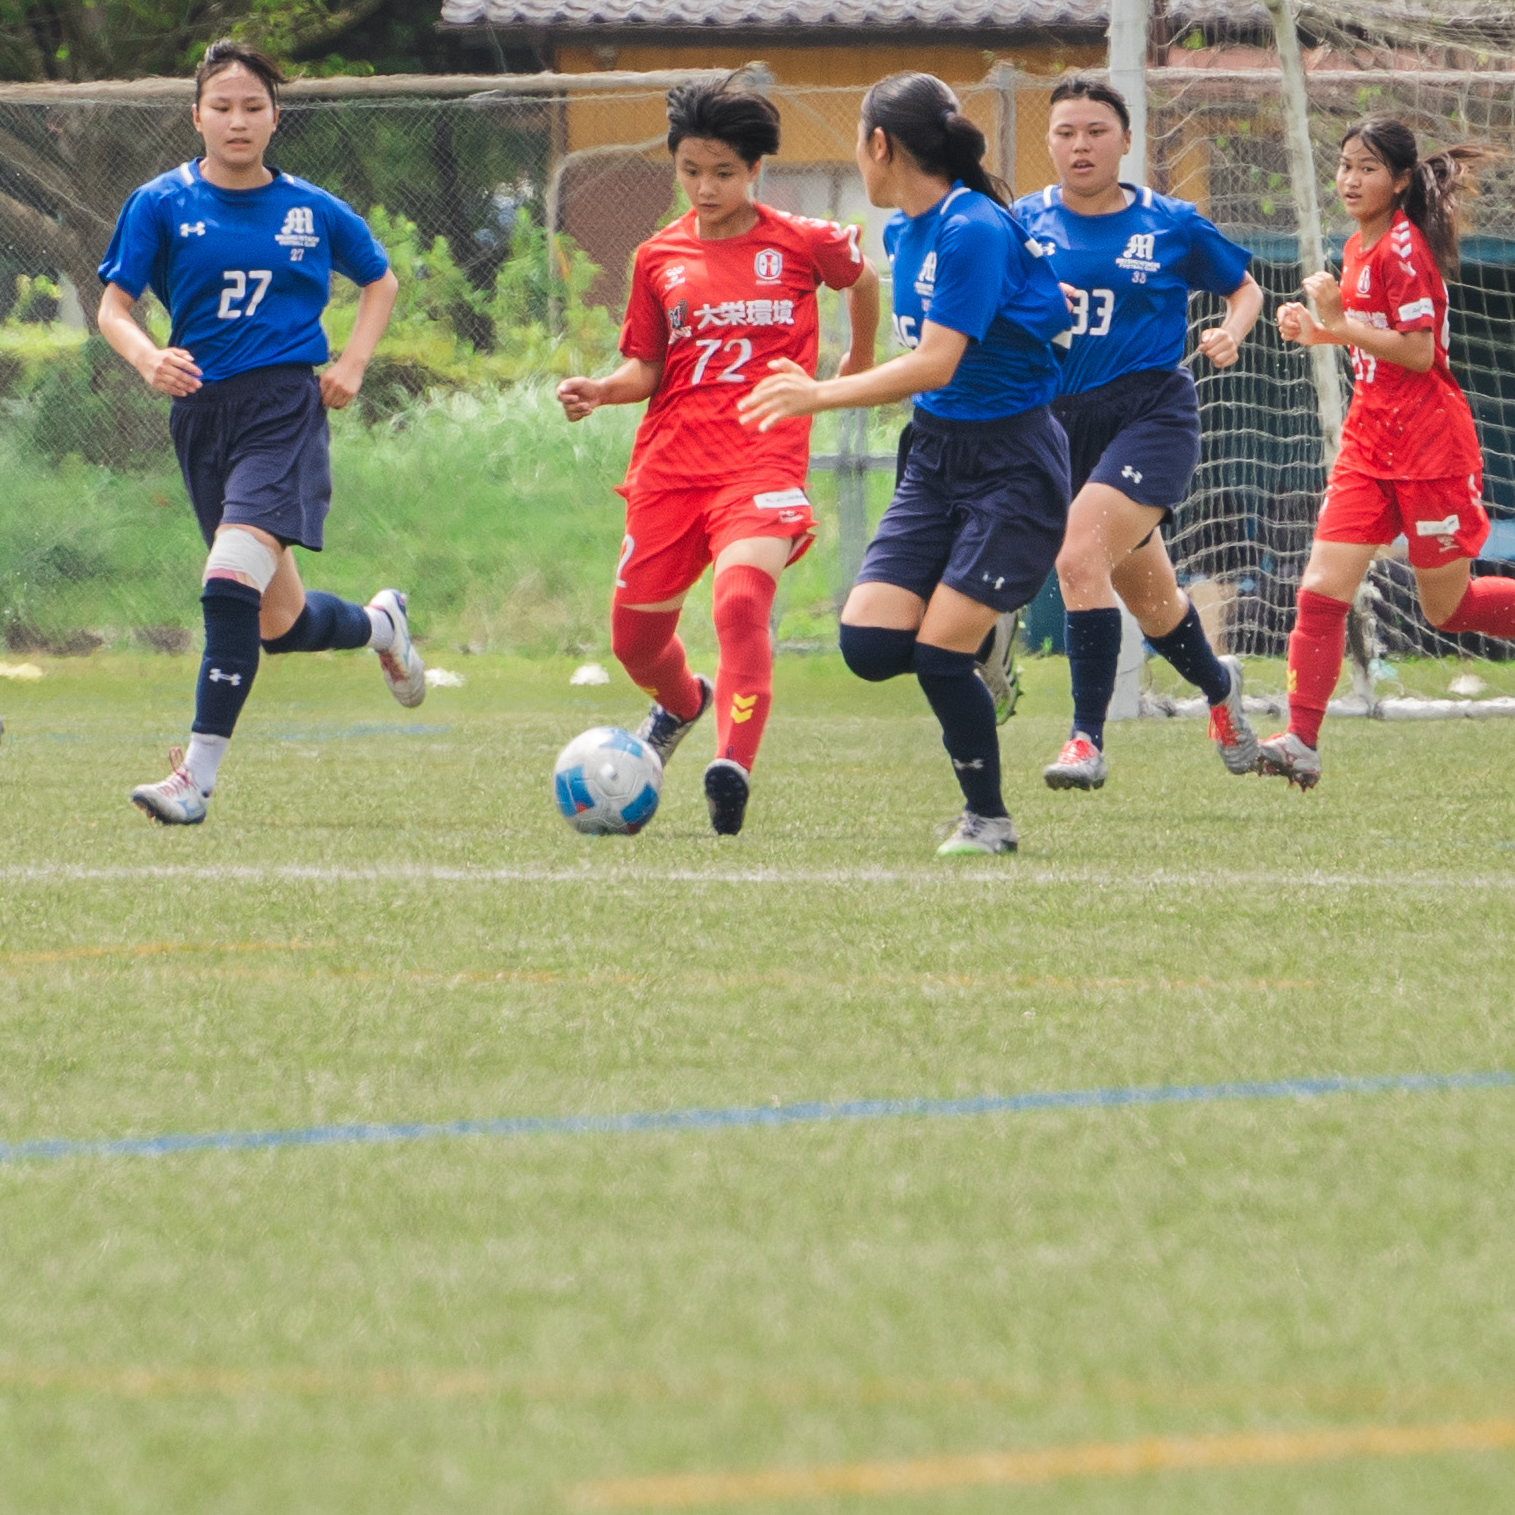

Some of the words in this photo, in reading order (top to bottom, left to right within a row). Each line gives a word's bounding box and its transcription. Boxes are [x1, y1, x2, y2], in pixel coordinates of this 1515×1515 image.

[290, 248, 304, 261] 27
[217, 270, 272, 318] 27
[693, 299, 795, 330] 大栄環境
[1071, 288, 1115, 335] 33
[691, 338, 752, 385] 72
